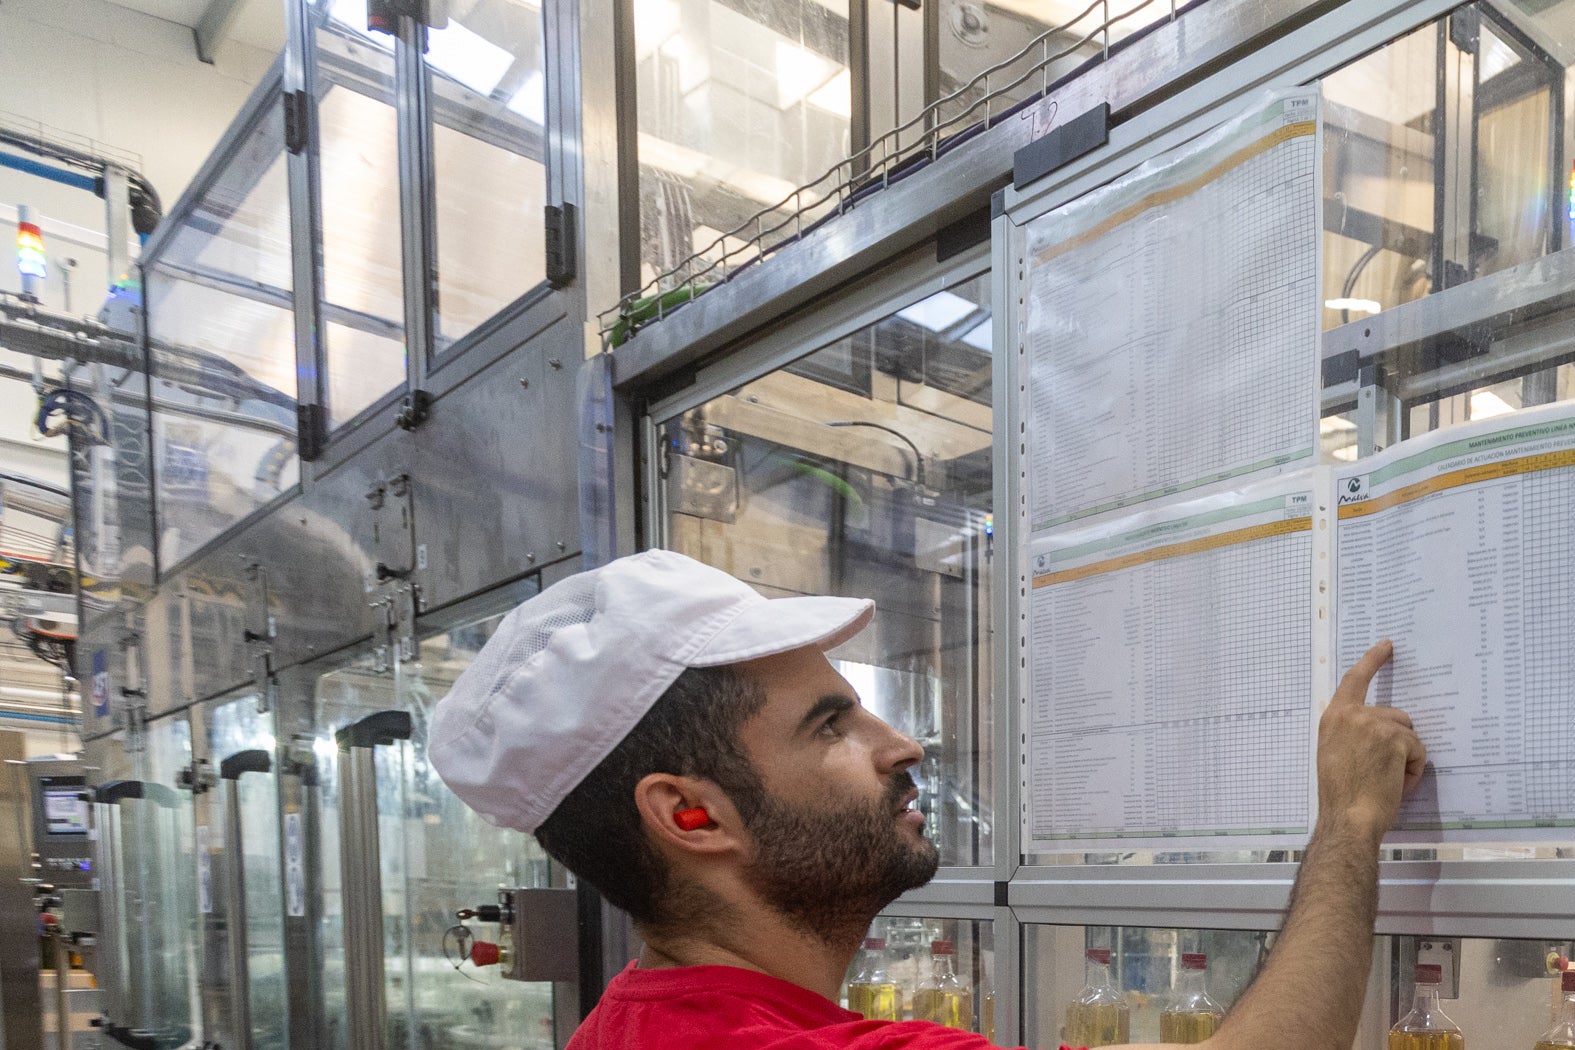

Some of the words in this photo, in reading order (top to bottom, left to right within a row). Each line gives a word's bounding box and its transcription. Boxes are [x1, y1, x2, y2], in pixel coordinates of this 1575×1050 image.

[1468, 433, 1514, 449] MANTENIMIENTO
[1514, 426, 1550, 439] PREVENTIVO
[1505, 442, 1552, 456] MANTENIMIENTO
[1292, 495, 1307, 503] TPM
